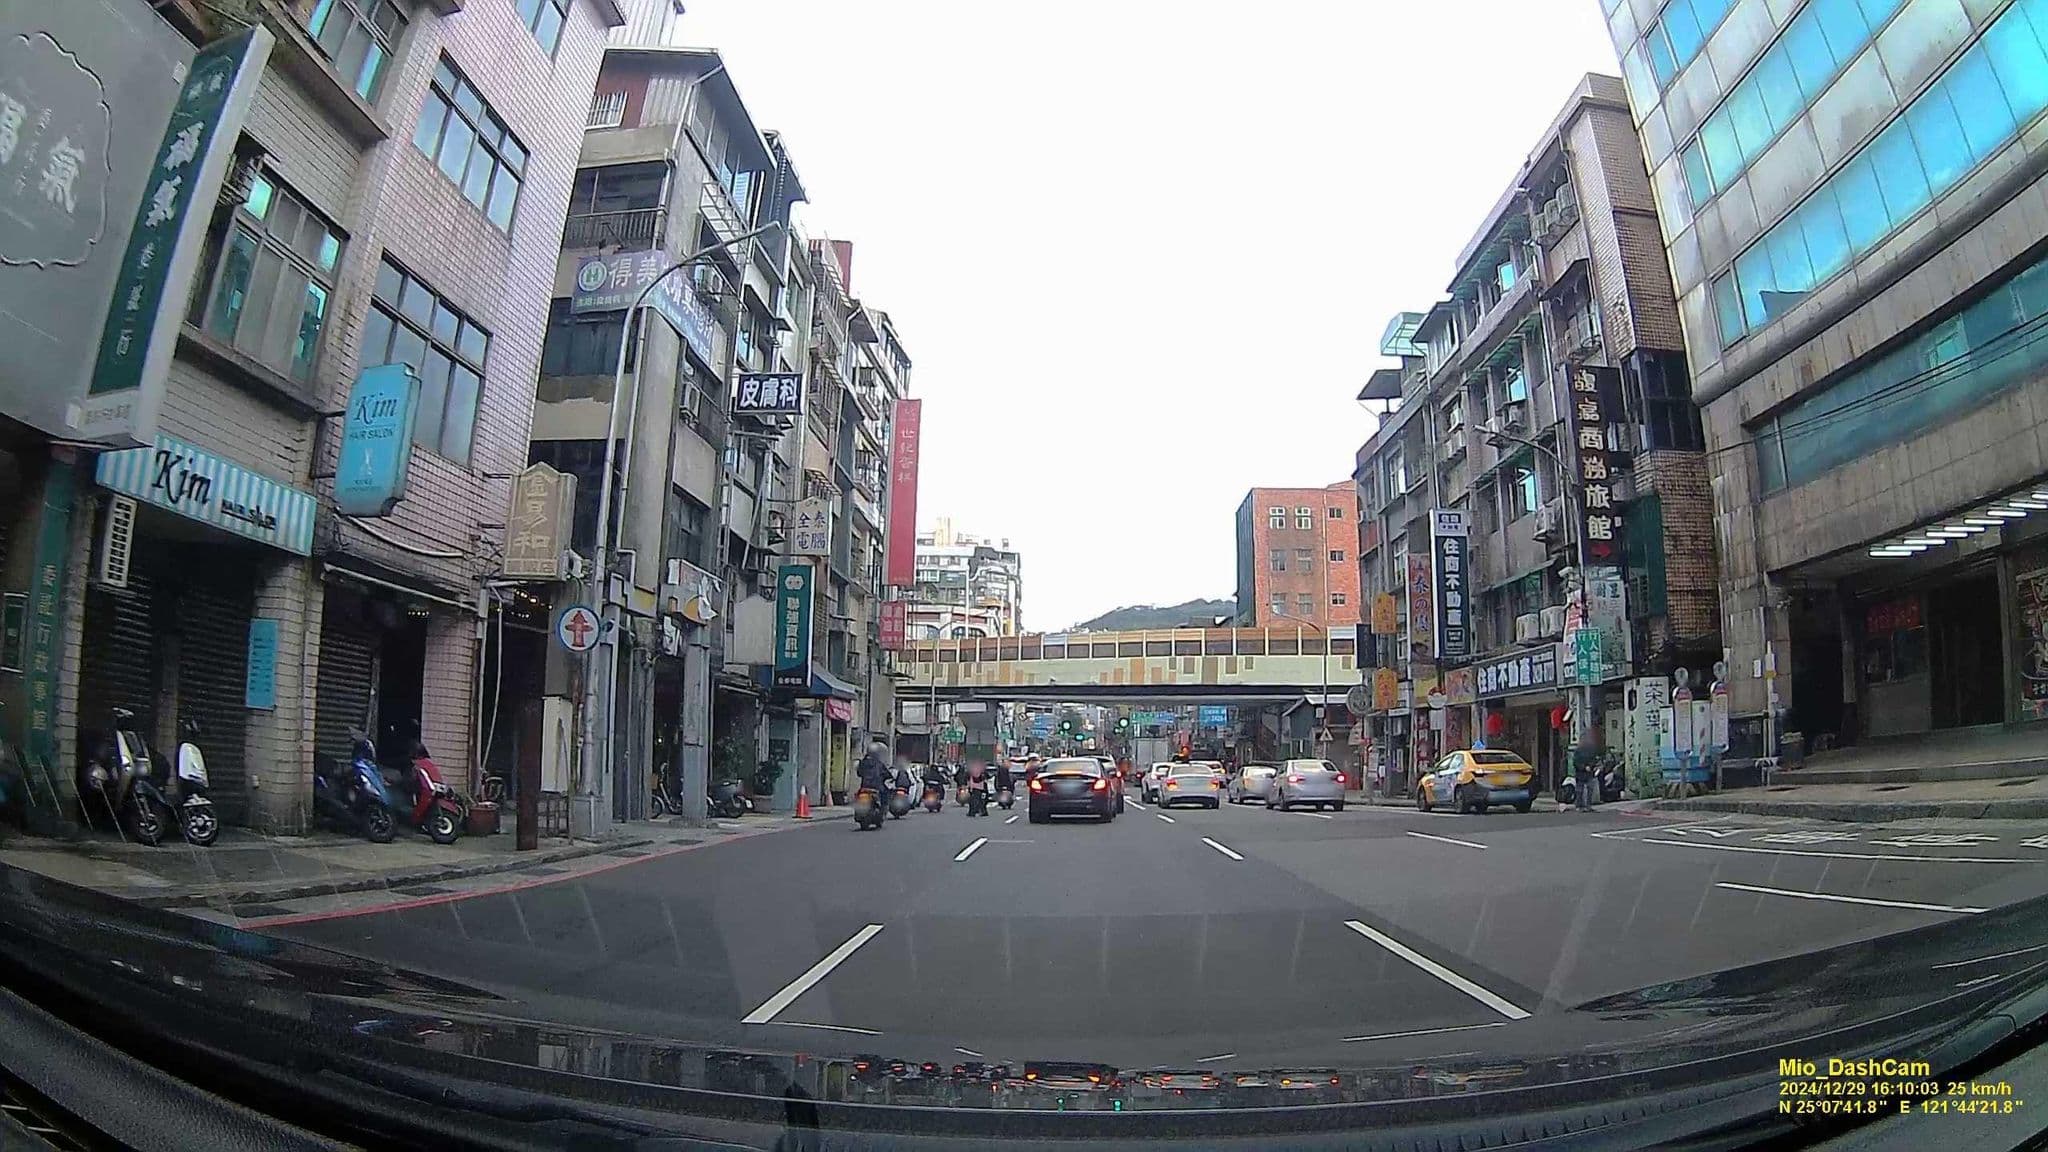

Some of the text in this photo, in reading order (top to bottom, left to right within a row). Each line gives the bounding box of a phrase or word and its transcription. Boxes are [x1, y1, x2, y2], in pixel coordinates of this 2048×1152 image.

[353, 392, 398, 425] Kim
[740, 377, 798, 408] 皮膚科
[152, 449, 213, 505] Kim
[1443, 537, 1463, 626] 住商不動產
